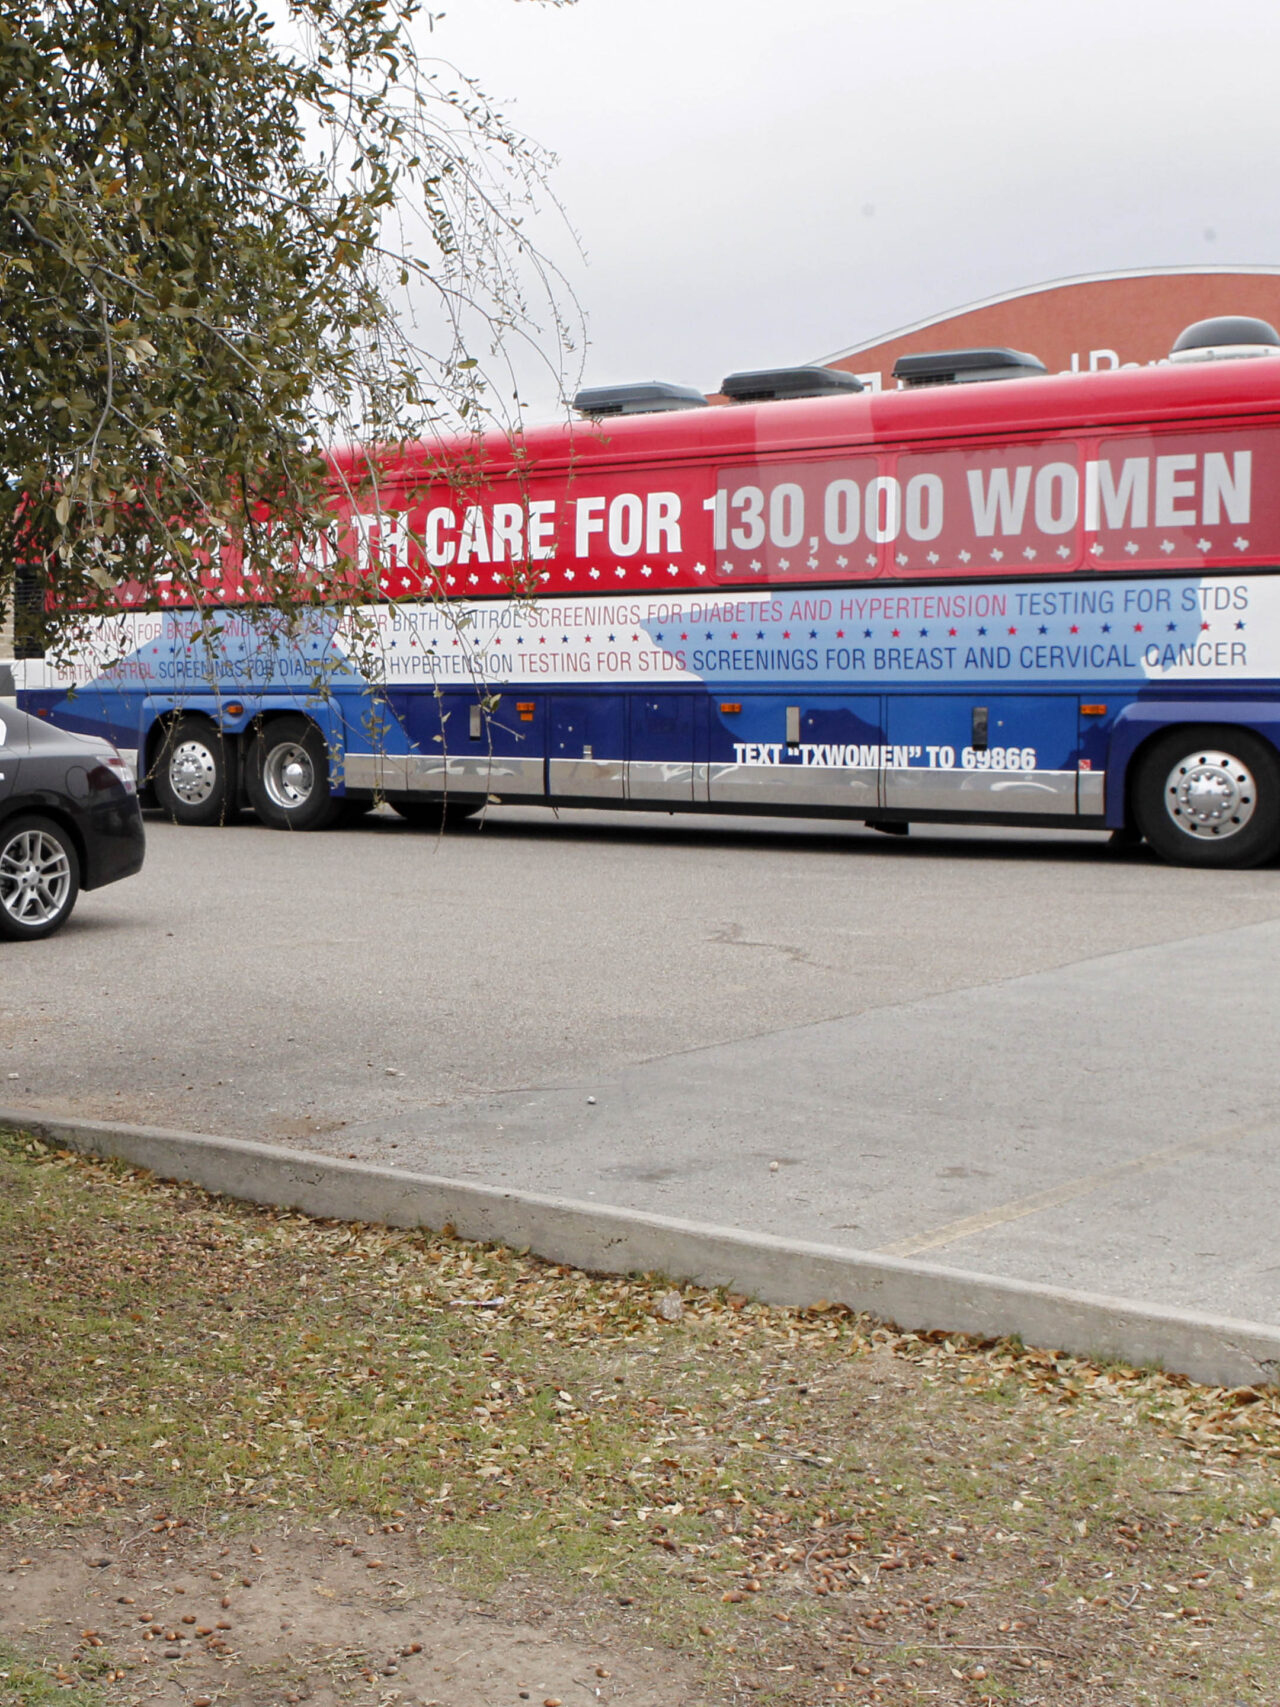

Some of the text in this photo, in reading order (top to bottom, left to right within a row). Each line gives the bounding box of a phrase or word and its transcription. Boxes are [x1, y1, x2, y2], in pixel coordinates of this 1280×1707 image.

[425, 500, 556, 567] CARE
[575, 491, 683, 558] FOR
[703, 472, 944, 555] 130,000
[966, 450, 1253, 537] WOMEN
[138, 621, 163, 642] FOR
[393, 611, 439, 632] BIRTH
[444, 608, 522, 632] CONTROL
[528, 604, 641, 628] SCREENINGS
[647, 602, 683, 625] FOR
[689, 600, 783, 623] DIABETES
[789, 599, 832, 621] AND
[840, 594, 1007, 620] HYPERTENSION
[1015, 590, 1114, 616] TESTING
[1124, 588, 1171, 613] FOR
[1180, 585, 1249, 611] STDS
[57, 662, 92, 681] BIRTH
[159, 659, 243, 679] SCREENNGS
[390, 654, 513, 675] HYPERTENSION
[517, 651, 592, 674] TESTING
[597, 651, 632, 672] FOR
[638, 650, 687, 671] STDS
[693, 649, 819, 671] SCREENINGS
[826, 648, 866, 670] FOR
[874, 647, 957, 670] BREAST
[964, 646, 1011, 669] AND
[1020, 644, 1137, 668] CERVICAL
[1145, 642, 1248, 667] CANCER
[733, 743, 783, 765] TEXT
[926, 746, 956, 769] TO
[961, 746, 1037, 770] 69866
